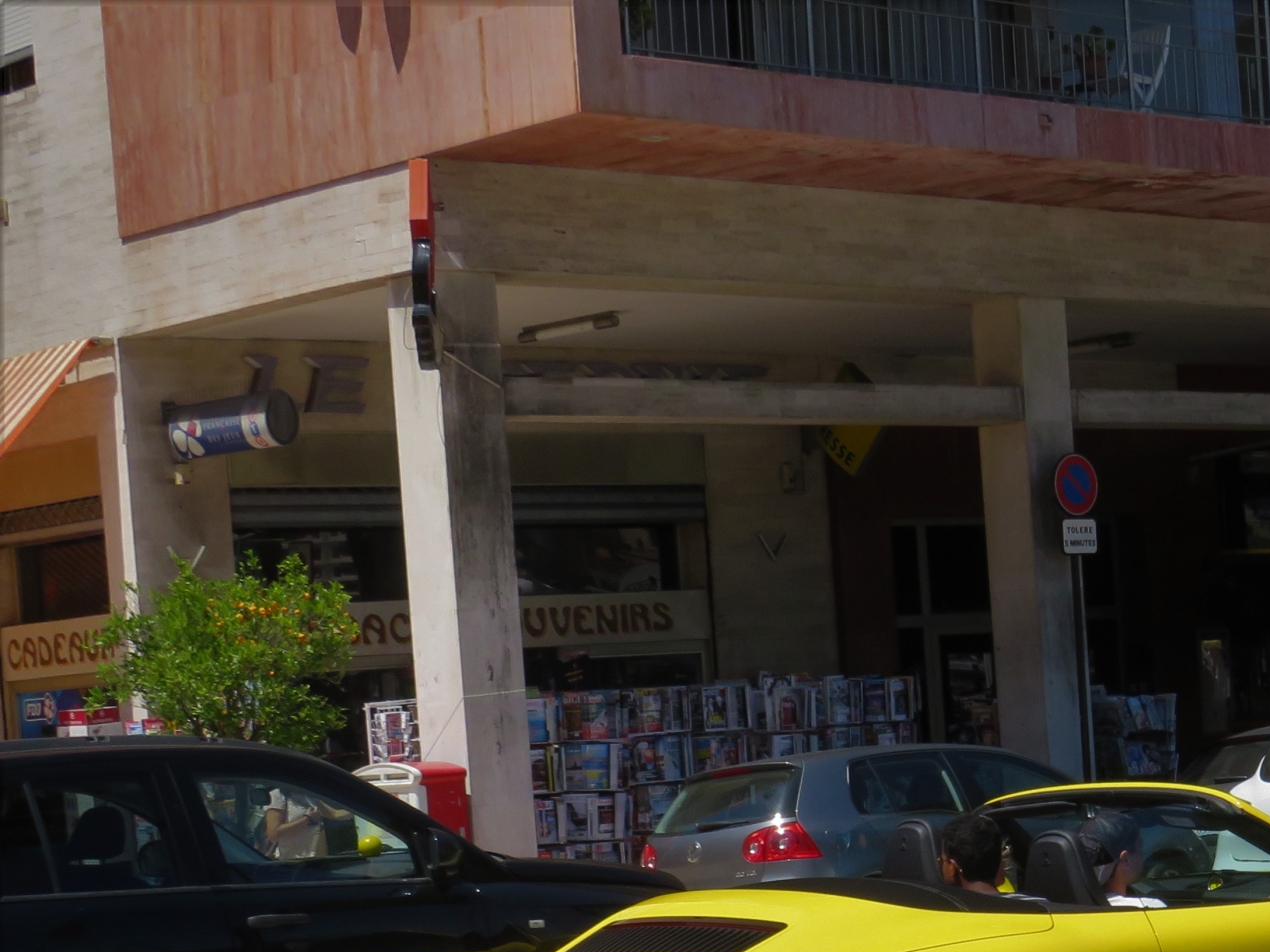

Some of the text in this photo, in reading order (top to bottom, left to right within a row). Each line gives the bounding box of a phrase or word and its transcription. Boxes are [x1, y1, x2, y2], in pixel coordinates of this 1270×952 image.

[1066, 526, 1093, 534] TOLERE
[1065, 538, 1096, 547] 5 MINUTES
[522, 602, 675, 638] UVENIRS
